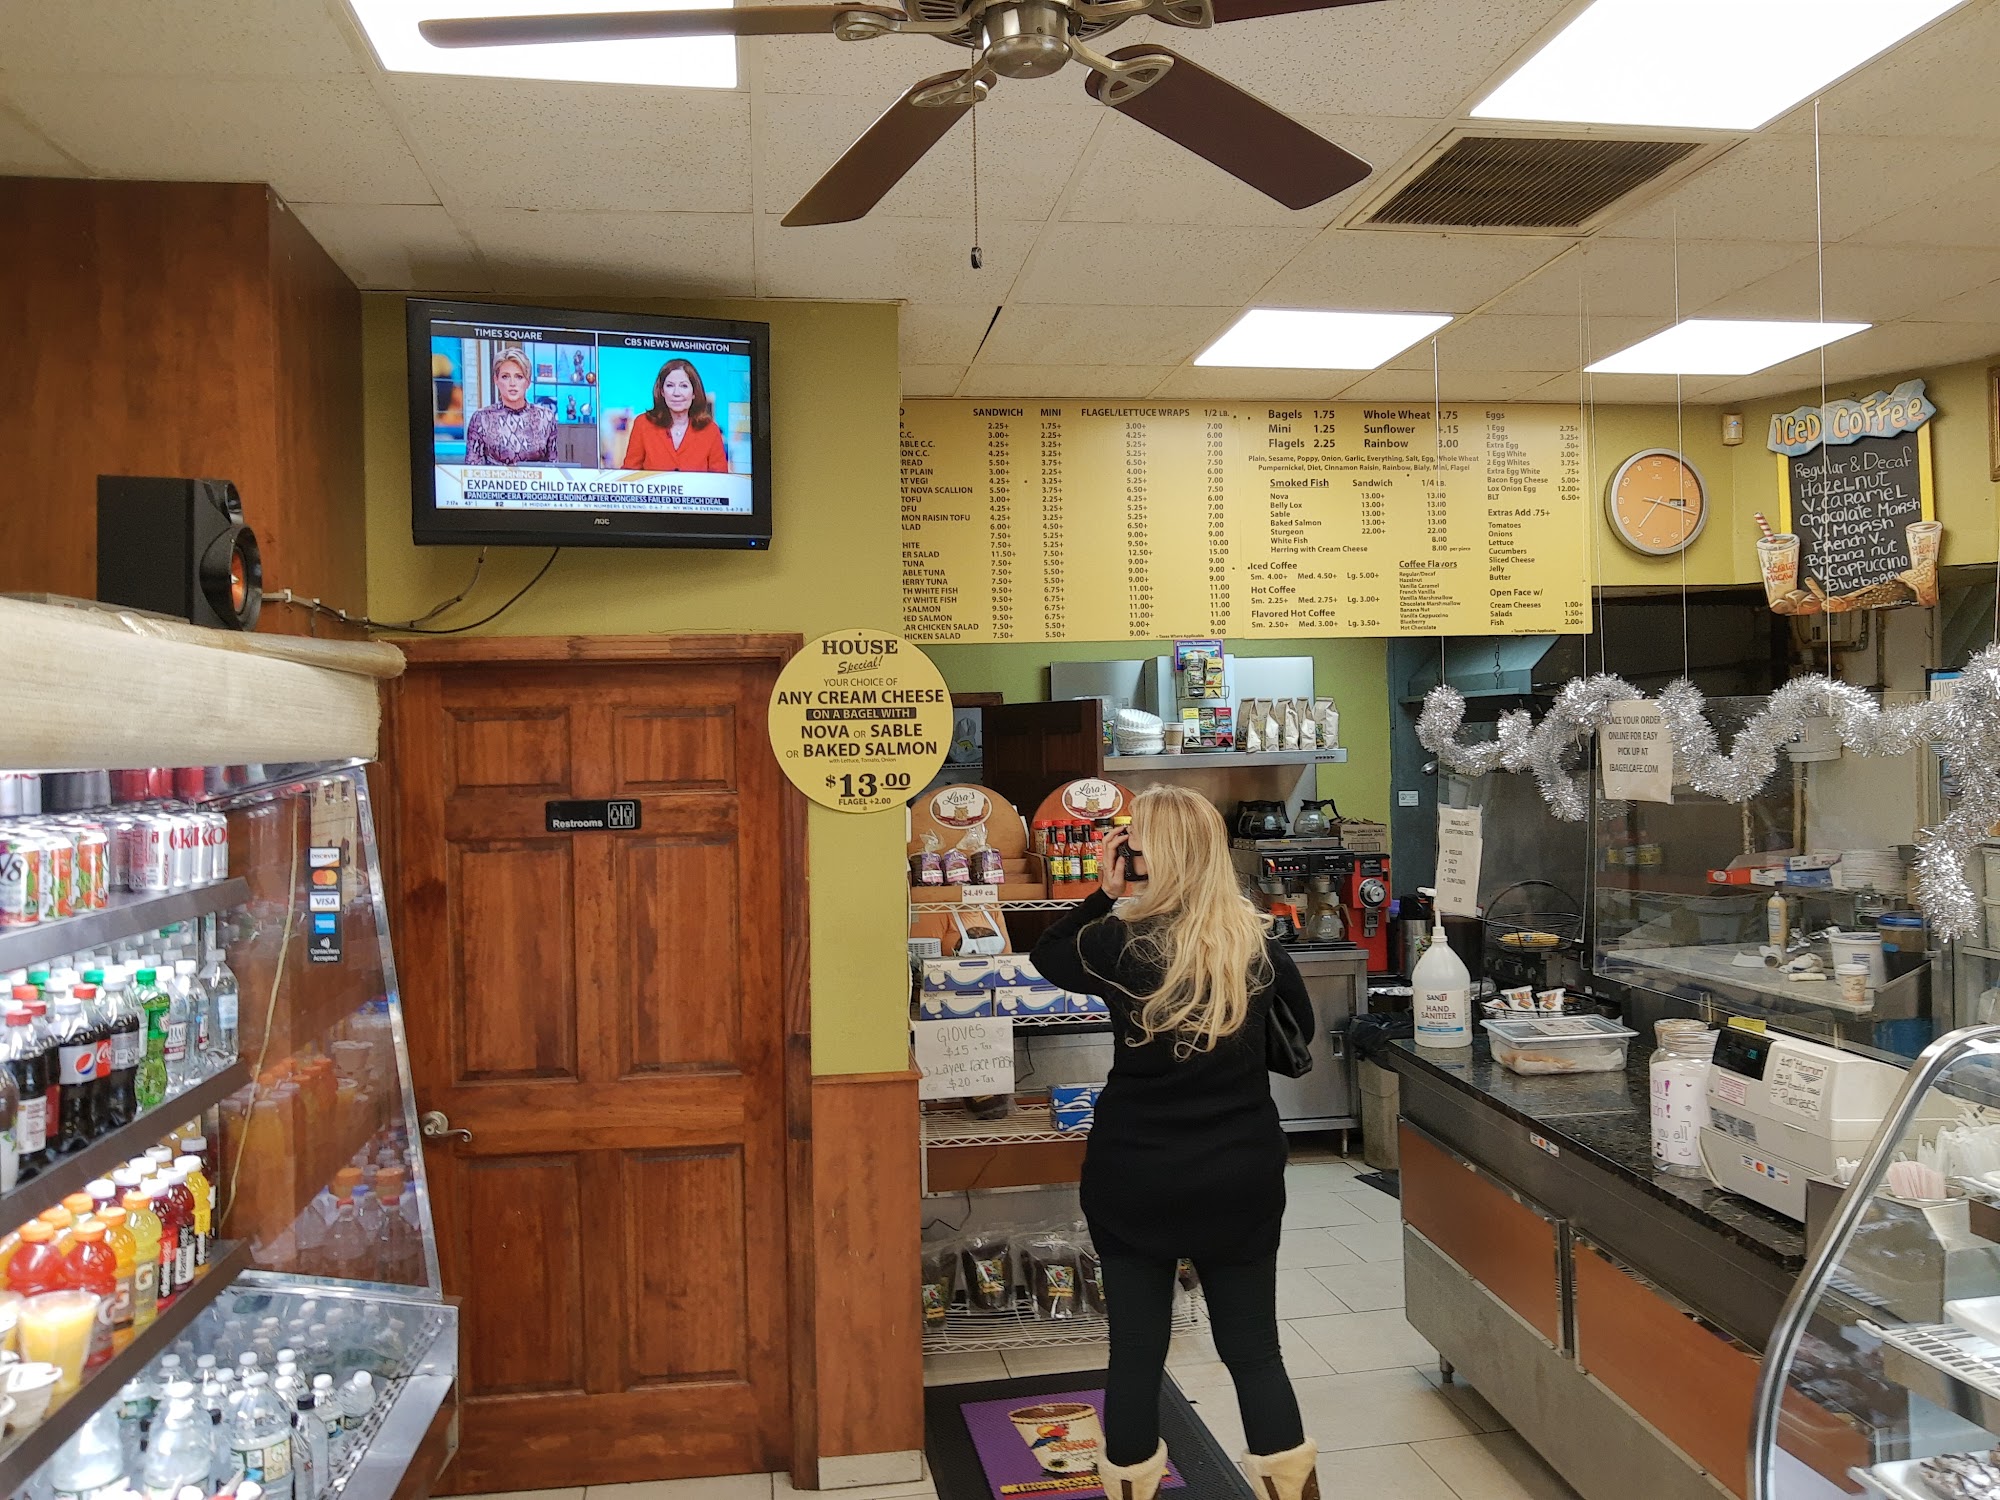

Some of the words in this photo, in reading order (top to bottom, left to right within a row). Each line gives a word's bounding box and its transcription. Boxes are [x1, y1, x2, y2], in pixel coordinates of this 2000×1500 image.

[475, 329, 501, 339] TIMES
[504, 330, 542, 340] SQUARE
[625, 338, 642, 347] CBS
[644, 339, 669, 348] NEWS
[670, 341, 729, 352] WASHINGTON
[973, 408, 1023, 417] SANDWICH
[1040, 409, 1061, 417] MINI
[1081, 409, 1157, 417] FLAGEL/LETTUCE
[1158, 409, 1190, 417] WRAPS
[1204, 409, 1217, 417] 1/2
[1268, 410, 1302, 420] Bagels
[1313, 410, 1335, 419] 1.75
[1363, 410, 1395, 420] Whole
[1398, 410, 1431, 420] Wheat
[1268, 424, 1291, 434] Mini
[1313, 424, 1335, 434] 1.25
[1364, 424, 1415, 434] Sunflower
[1269, 438, 1305, 449] Flagels
[1313, 439, 1335, 448] 2.25
[1364, 439, 1409, 448] Rainbow
[1850, 456, 1863, 472] &
[1865, 446, 1912, 470] Decaf
[492, 471, 540, 479] MORNINGS
[1270, 478, 1307, 487] Smoked
[1310, 479, 1329, 487] Fish
[1352, 479, 1393, 487] Sandwich
[1507, 477, 1520, 485] Egg
[467, 479, 527, 491] EXPANDED
[531, 481, 564, 492] CHILD
[567, 481, 587, 493] TAX
[589, 482, 627, 494] CREDIT
[628, 483, 644, 494] TO
[647, 484, 683, 495] EXPIRE
[467, 492, 522, 500] PANDEMIC-ERA
[523, 493, 557, 501] PROGRAM
[559, 494, 587, 502] ENDING
[610, 495, 648, 503] CONGRESS
[671, 497, 682, 505] TO
[1270, 502, 1289, 510] Belly
[1488, 509, 1511, 517] Extras
[1513, 509, 1531, 517] Add
[1533, 509, 1550, 517] .75+
[1399, 561, 1425, 569] Coffee
[1427, 560, 1458, 568] Flavors
[1268, 586, 1296, 594] Coffee
[936, 632, 961, 640] SALAD
[822, 640, 897, 655] HOUSE
[837, 656, 883, 675] Special!
[824, 678, 848, 687] YOUR
[851, 678, 884, 686] CHOICE
[888, 678, 897, 686] OF
[778, 691, 812, 705] ANY
[817, 691, 877, 704] CREAM
[882, 690, 944, 703] CHEESE
[813, 709, 830, 719] ON
[832, 709, 840, 719] A
[844, 709, 879, 718] BAGEL
[881, 709, 910, 717] WITH
[1623, 716, 1639, 724] YOUR
[1641, 716, 1661, 724] ORDER
[801, 725, 849, 738] NOVA
[871, 724, 922, 737] SABLE
[1631, 732, 1641, 740] FOR
[1643, 732, 1658, 740] EASY
[786, 750, 799, 758] OR
[804, 744, 860, 757] BAKED
[865, 742, 937, 755] SALMON
[1075, 785, 1107, 797] Lara's
[942, 792, 975, 804] Lara's
[553, 819, 603, 828] Restrooms
[947, 1077, 970, 1091] $20
